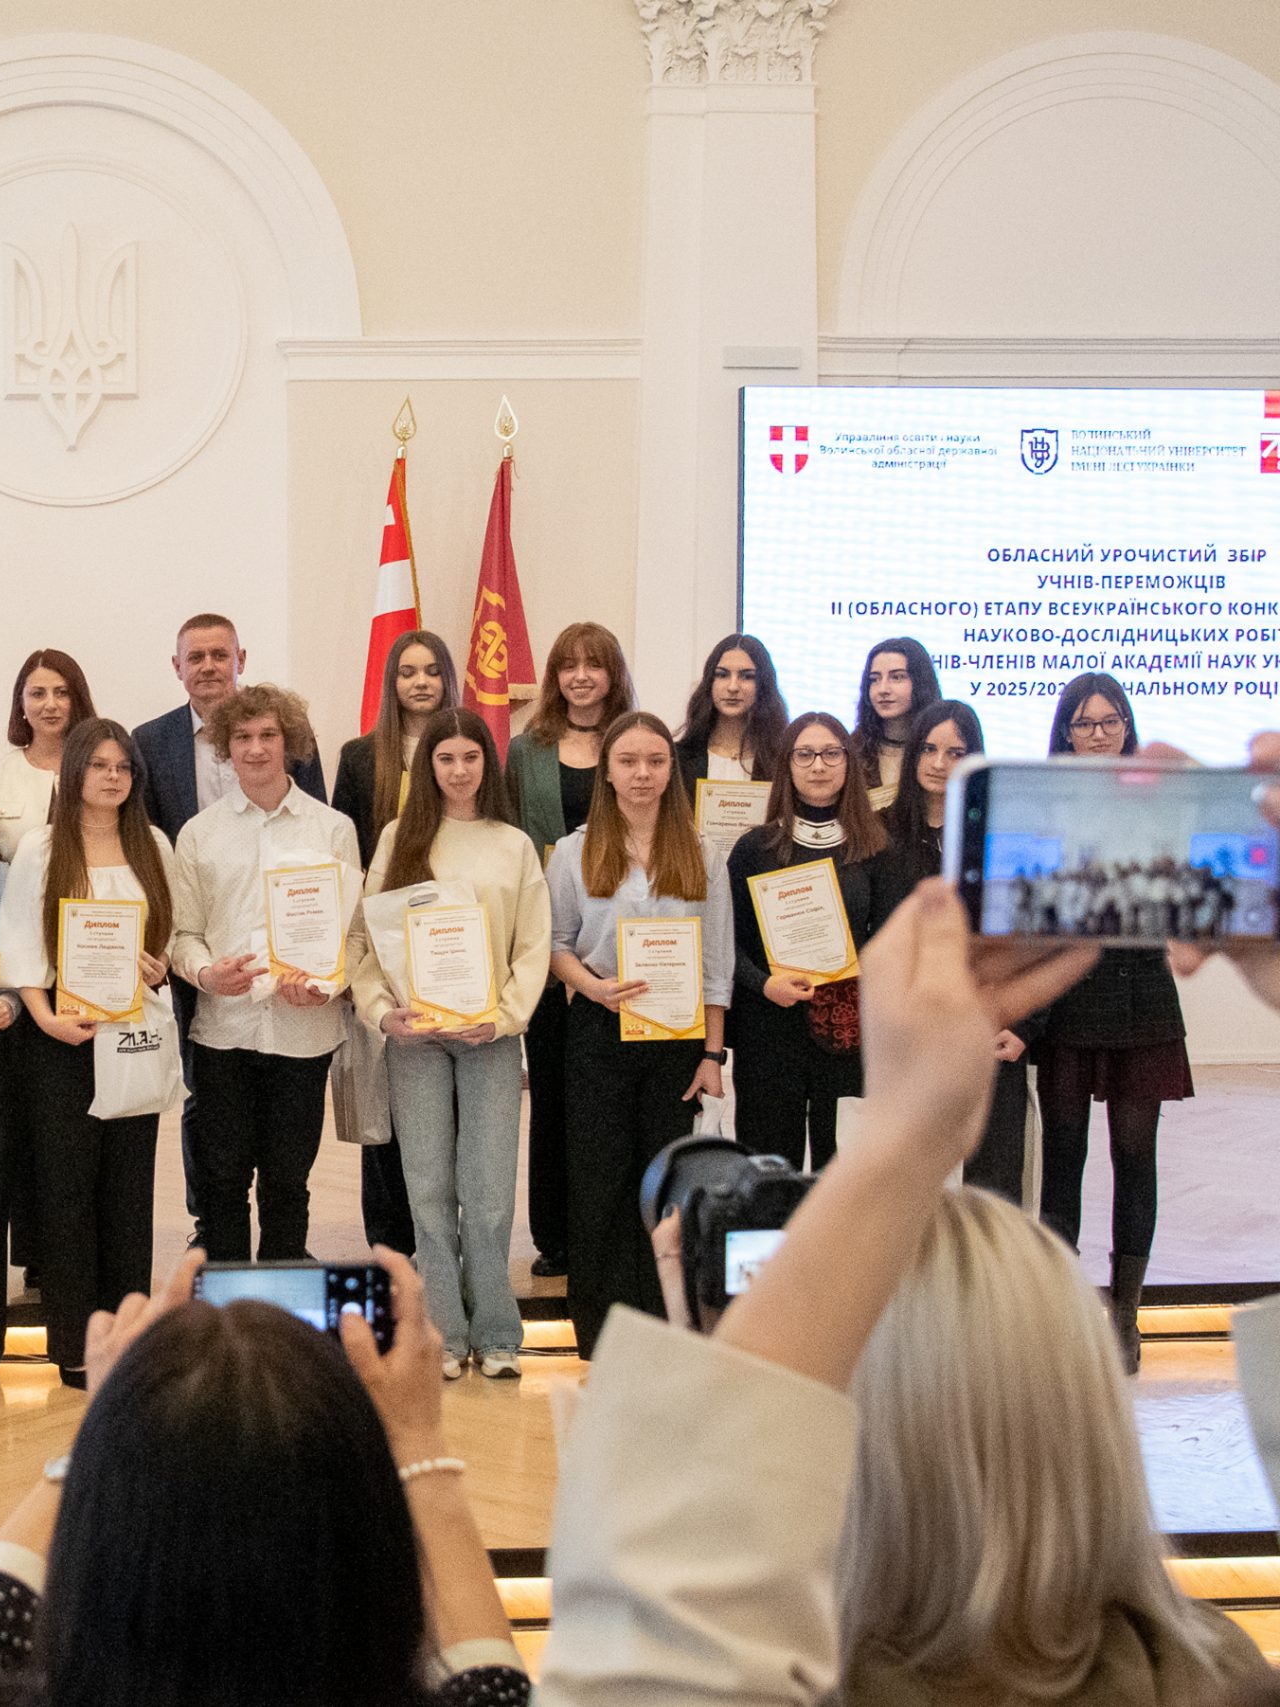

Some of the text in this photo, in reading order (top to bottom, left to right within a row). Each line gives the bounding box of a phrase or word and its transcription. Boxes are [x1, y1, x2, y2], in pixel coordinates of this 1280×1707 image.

[987, 543, 1267, 562] ОБЛАСНИЙ УРОЧИСТИЙ ЗБІР
[1037, 575, 1226, 593] УЧНІВ-ПЕРЕМОЖЦІВ
[848, 601, 978, 618] (ОБЛАСНОГО)
[984, 602, 1042, 615] ЕТАПУ
[1048, 598, 1222, 616] ВСЕУКРАЇНСЬКОГО
[964, 628, 1280, 647] НАУКОВО-ДОСЛІДНИЦЬКИХ РОБІ
[933, 655, 1036, 670] НІВ-ЧЛЕНІВ
[1042, 652, 1107, 670] МАЛОЇ
[1111, 651, 1203, 673] АКАДЕМІЇ
[1207, 655, 1257, 670] НАУК
[970, 682, 1278, 699] У 2025/202 ЧАЛЬНОМУ РОЦІ
[718, 800, 752, 808] Диплом
[778, 885, 813, 900] Диплом
[84, 920, 120, 929] Диплом
[642, 938, 677, 948] Диплом
